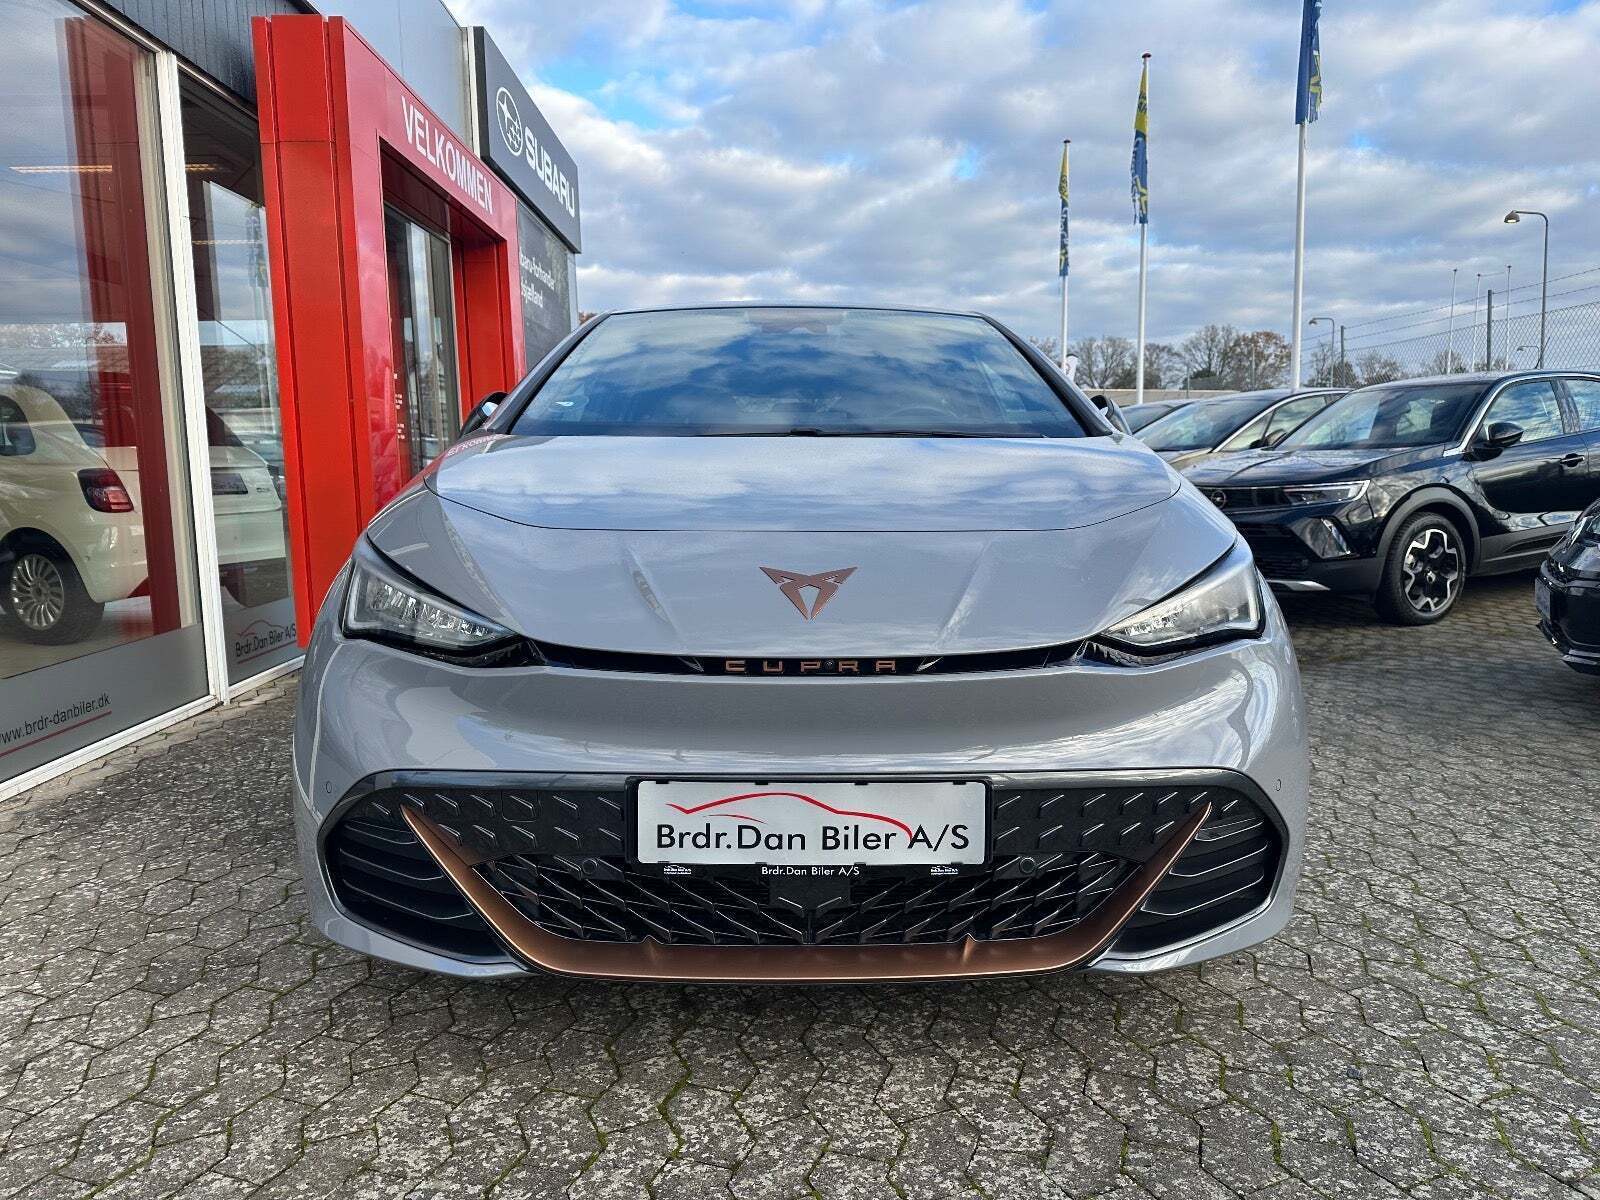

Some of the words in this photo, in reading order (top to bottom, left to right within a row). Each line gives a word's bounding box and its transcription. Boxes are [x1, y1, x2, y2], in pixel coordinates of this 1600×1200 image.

[401, 95, 494, 215] VELKOMMEN
[524, 126, 576, 218] SUBARU
[725, 660, 896, 673] CUPRA
[0, 692, 111, 744] ww.brdr-danbiler.dk
[656, 823, 806, 850] Brdr.Dan
[822, 824, 897, 851] Biler
[908, 824, 969, 852] A/S
[761, 866, 808, 876] Brdr.Dan
[811, 866, 835, 876] Biler
[839, 866, 860, 876] A/S
